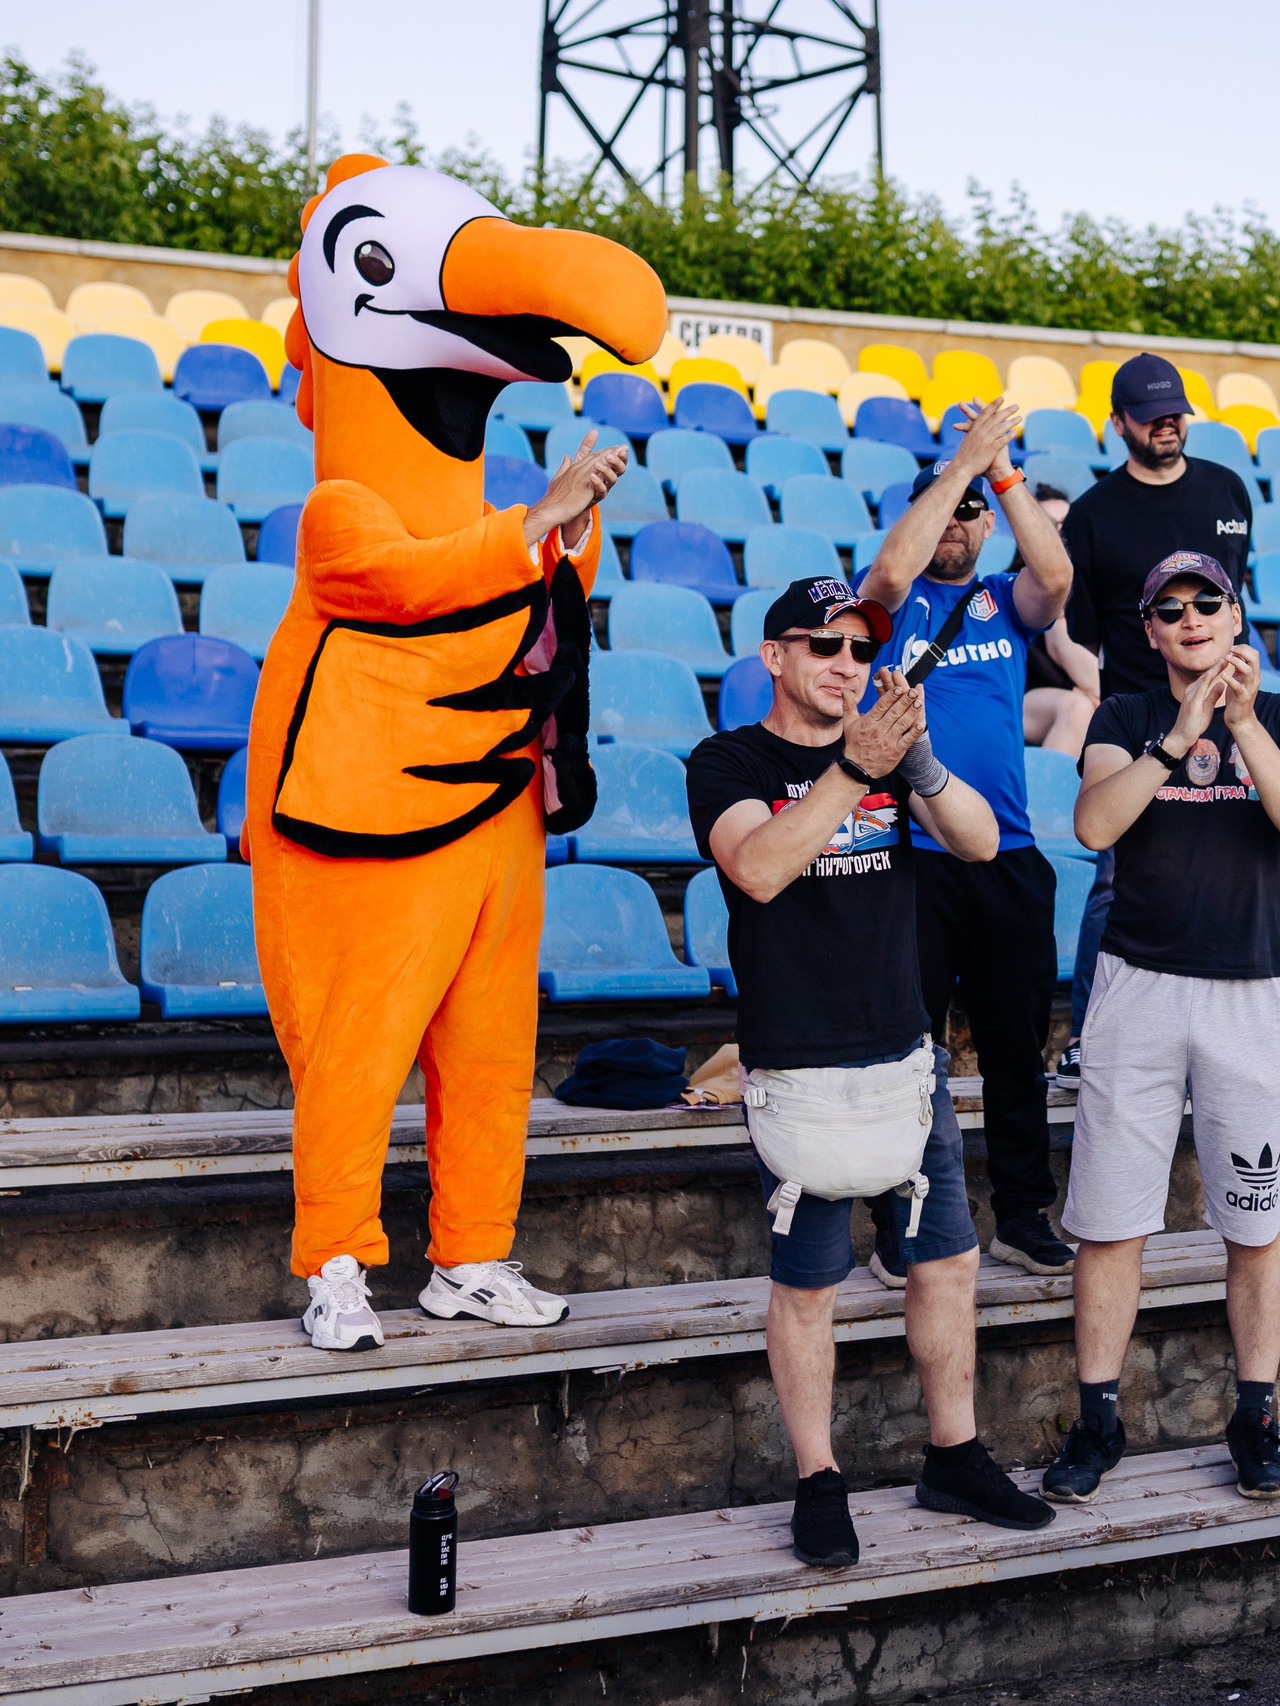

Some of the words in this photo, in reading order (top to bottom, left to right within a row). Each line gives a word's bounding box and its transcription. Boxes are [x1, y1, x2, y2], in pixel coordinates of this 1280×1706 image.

[1216, 518, 1248, 535] Actual
[1156, 785, 1214, 802] СТАЛЬНОЙ
[1214, 785, 1247, 800] ГРАД
[802, 850, 892, 877] ГНИТОГОРСК
